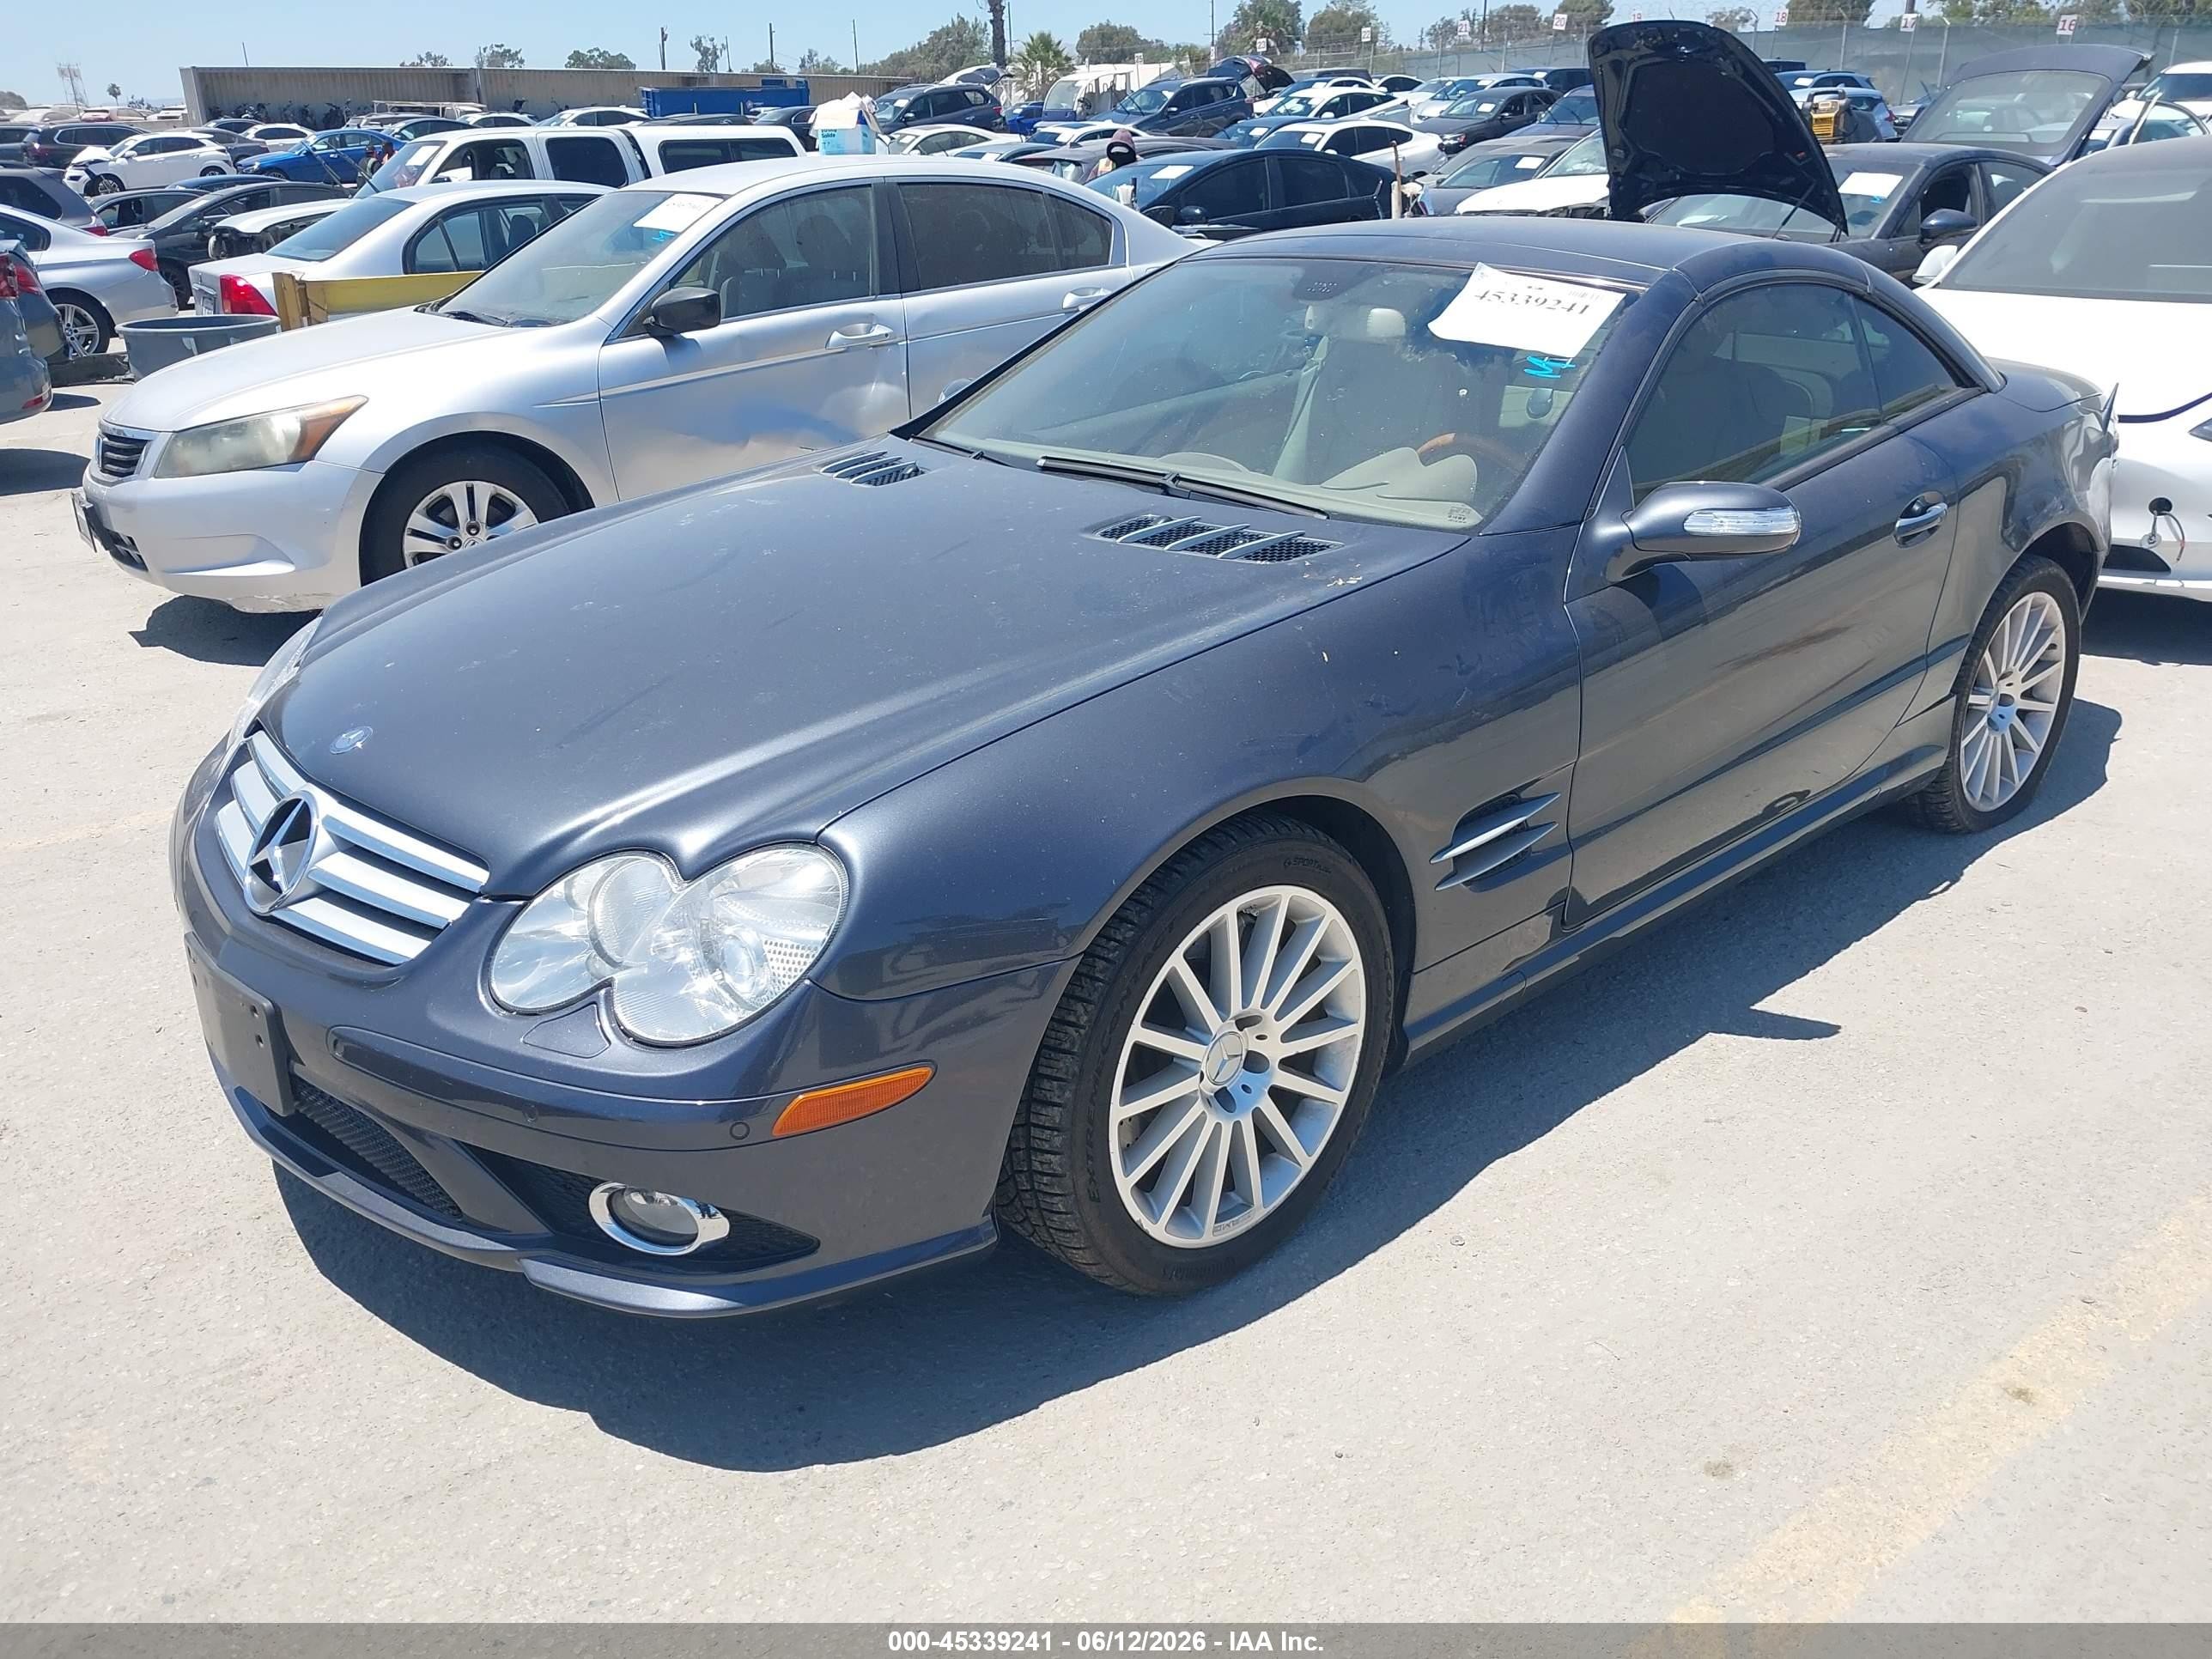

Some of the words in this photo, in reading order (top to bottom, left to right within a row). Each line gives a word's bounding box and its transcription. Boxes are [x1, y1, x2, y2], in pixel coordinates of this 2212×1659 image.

[1555, 16, 1566, 27] 20
[1775, 12, 1787, 22] 18
[1902, 17, 1916, 28] 17
[1459, 23, 1468, 33] 21
[2059, 20, 2075, 31] 16
[1363, 30, 1370, 39] 22
[1474, 289, 1589, 314] 45339241
